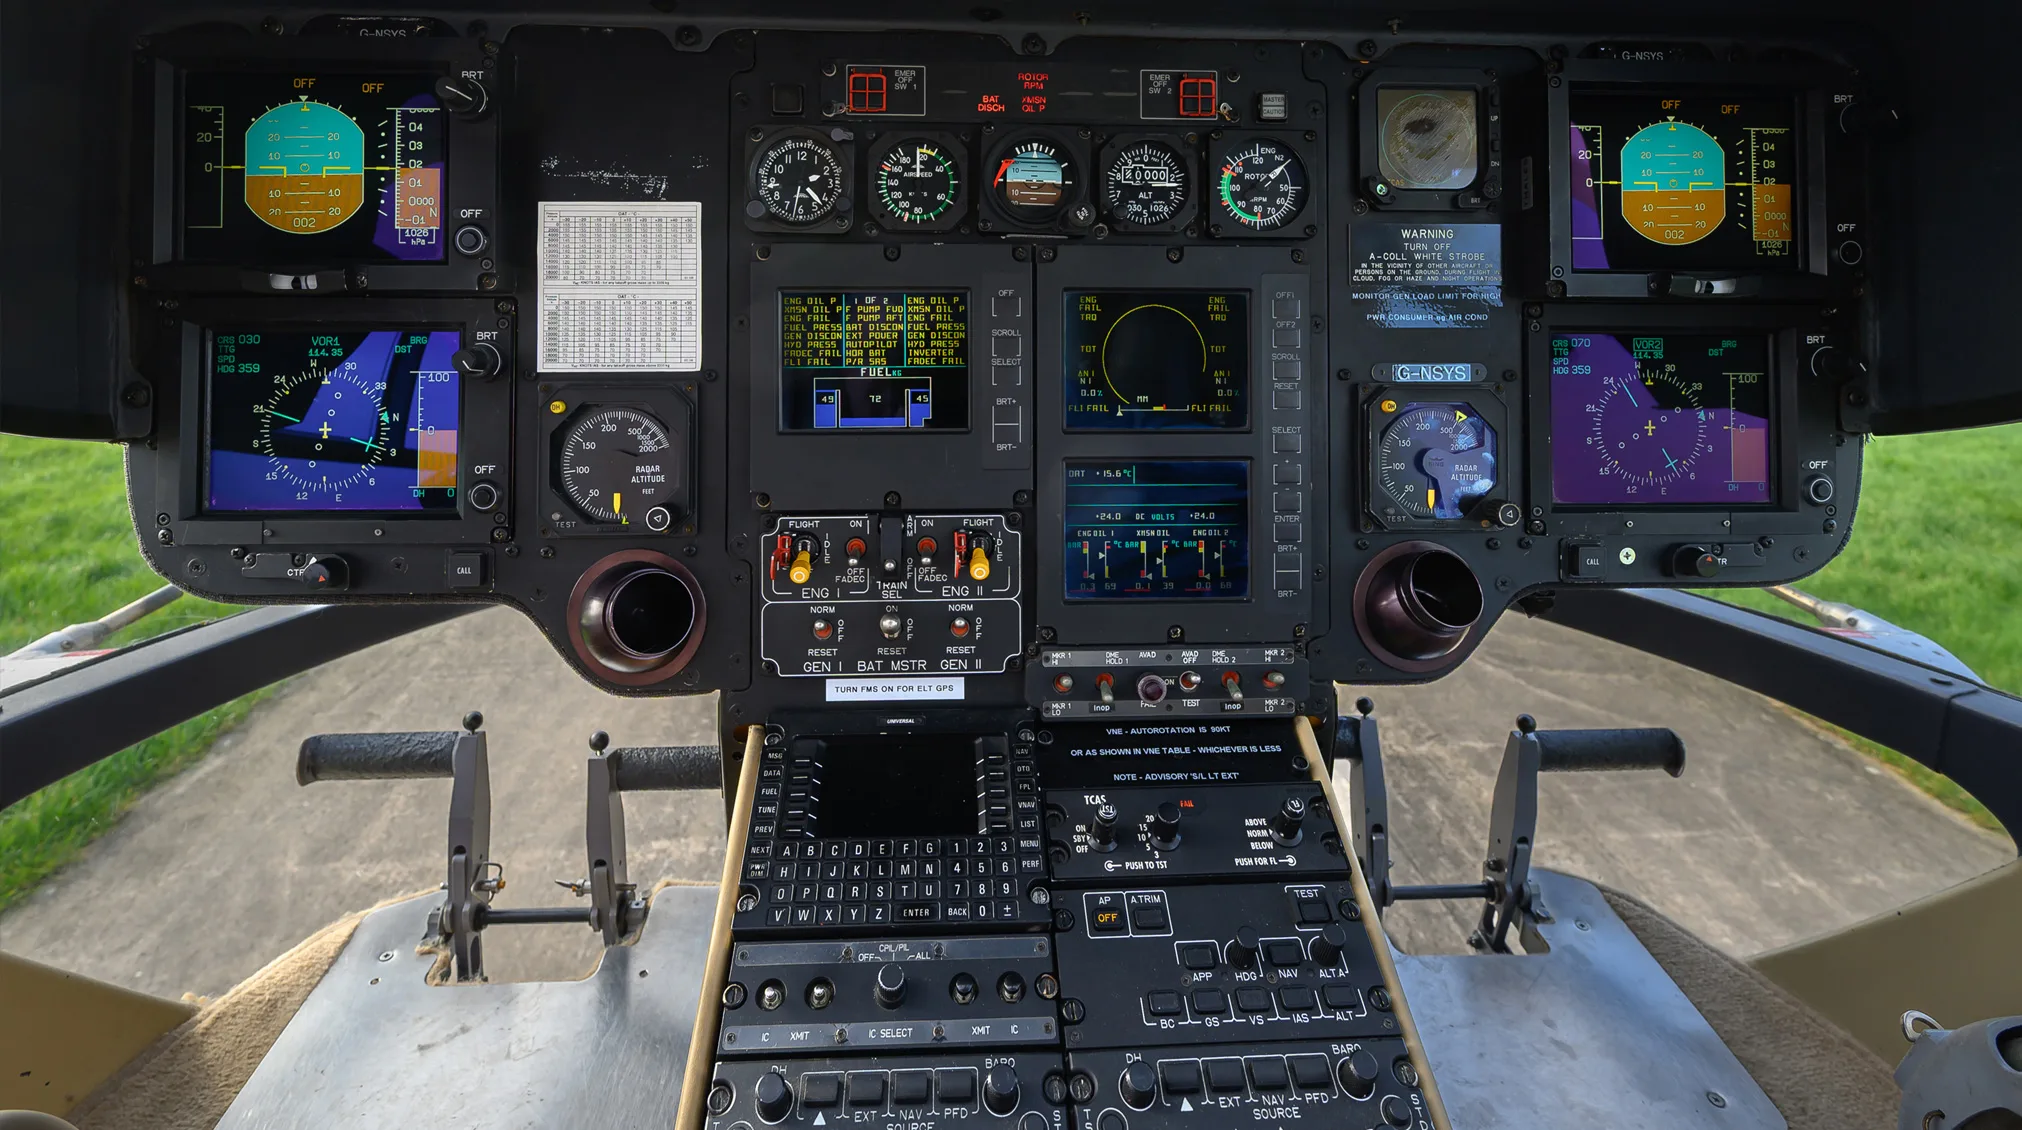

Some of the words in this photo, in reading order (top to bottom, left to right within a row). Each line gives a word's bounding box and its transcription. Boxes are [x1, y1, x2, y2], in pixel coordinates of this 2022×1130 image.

[1622, 51, 1664, 60] G-NSYS
[293, 78, 316, 89] OFF
[362, 83, 384, 93] OFF
[1024, 81, 1044, 90] RPM
[982, 95, 999, 103] BAT
[1834, 95, 1853, 103] BRT
[977, 103, 1005, 112] DISCH
[1661, 100, 1681, 110] OFF
[1721, 105, 1740, 114] OFF
[797, 151, 807, 161] 12
[1138, 191, 1153, 199] ALT
[460, 209, 483, 219] OFF
[293, 217, 316, 228] 002
[1837, 224, 1856, 232] OFF
[405, 229, 429, 237] 1026
[1401, 229, 1453, 239] WARNING
[1664, 230, 1685, 240] 002
[1208, 304, 1230, 312] FAIL
[813, 323, 842, 331] PRESS
[217, 336, 235, 344] CRS
[238, 334, 261, 344] 030
[410, 336, 428, 345] BRG
[476, 332, 498, 340] BRT
[1806, 336, 1825, 344] BRT
[311, 336, 340, 346] VOR1
[1552, 339, 1568, 347] CRS
[1571, 338, 1591, 348] 070
[1635, 340, 1661, 349] VOR2
[308, 348, 343, 357] 114.35
[217, 364, 235, 373] HDG
[238, 363, 260, 373] 359
[860, 367, 892, 376] FUEL
[1553, 366, 1569, 374] HDG
[1571, 365, 1591, 375] 359
[428, 372, 450, 382] 100
[1397, 366, 1466, 380] G-NSYS
[601, 424, 617, 432] 200
[474, 465, 495, 474] OFF
[635, 465, 660, 473] RADAR
[1809, 461, 1828, 469] OFF
[631, 475, 665, 483] ALTITUDE
[1451, 473, 1482, 481] ALTITUDE
[1586, 558, 1600, 566] CALL
[457, 566, 472, 575] CALL
[802, 588, 828, 599] ENG
[882, 590, 902, 599] SEL
[942, 586, 970, 597] ENG
[977, 586, 983, 596] II
[810, 606, 835, 614] NORM
[857, 661, 883, 671] BAT
[891, 661, 927, 671] MSTR
[1093, 704, 1110, 712] Inop
[1130, 726, 1195, 734] AUTOROTATION
[1210, 725, 1231, 733] 90KT
[1099, 748, 1131, 756] SHOWN
[1162, 747, 1191, 755] TABLE
[1197, 745, 1249, 754] WHICHEVER
[764, 769, 781, 777] DATA
[1113, 773, 1137, 781] NOTE
[1145, 772, 1189, 781] ADVISORY
[761, 787, 778, 796] FUEL
[1180, 800, 1194, 808] FAIL
[758, 806, 776, 814] TUNE
[1020, 820, 1036, 828] LIST
[1244, 818, 1267, 826] ABOVE
[754, 825, 773, 834] PREV
[1247, 829, 1269, 837] NORM
[1020, 839, 1039, 848] MENU
[1250, 841, 1274, 850] BELOW
[1125, 861, 1144, 870] PUSH
[1146, 861, 1154, 869] TO
[1156, 861, 1167, 869] TST
[1235, 857, 1253, 866] PUSH
[1255, 857, 1268, 866] FOR
[1269, 857, 1278, 865] FL
[1293, 888, 1319, 898] TEST
[1098, 896, 1111, 905] AP
[903, 908, 930, 917] ENTER
[948, 907, 967, 917] BACK
[1098, 913, 1118, 922] OFF
[878, 944, 910, 953] CPIL/PIL
[1193, 972, 1212, 982] APP
[1235, 972, 1257, 982] HDG
[1278, 969, 1298, 979] NAV
[1293, 1013, 1309, 1023] IAS
[1335, 1011, 1353, 1021] ALT
[790, 1031, 810, 1041] XMIT
[868, 1029, 876, 1038] IC
[880, 1028, 913, 1038] SELECT
[854, 1111, 877, 1122] EXT
[944, 1107, 968, 1119] PFD
[1253, 1107, 1301, 1119] SOURCE
